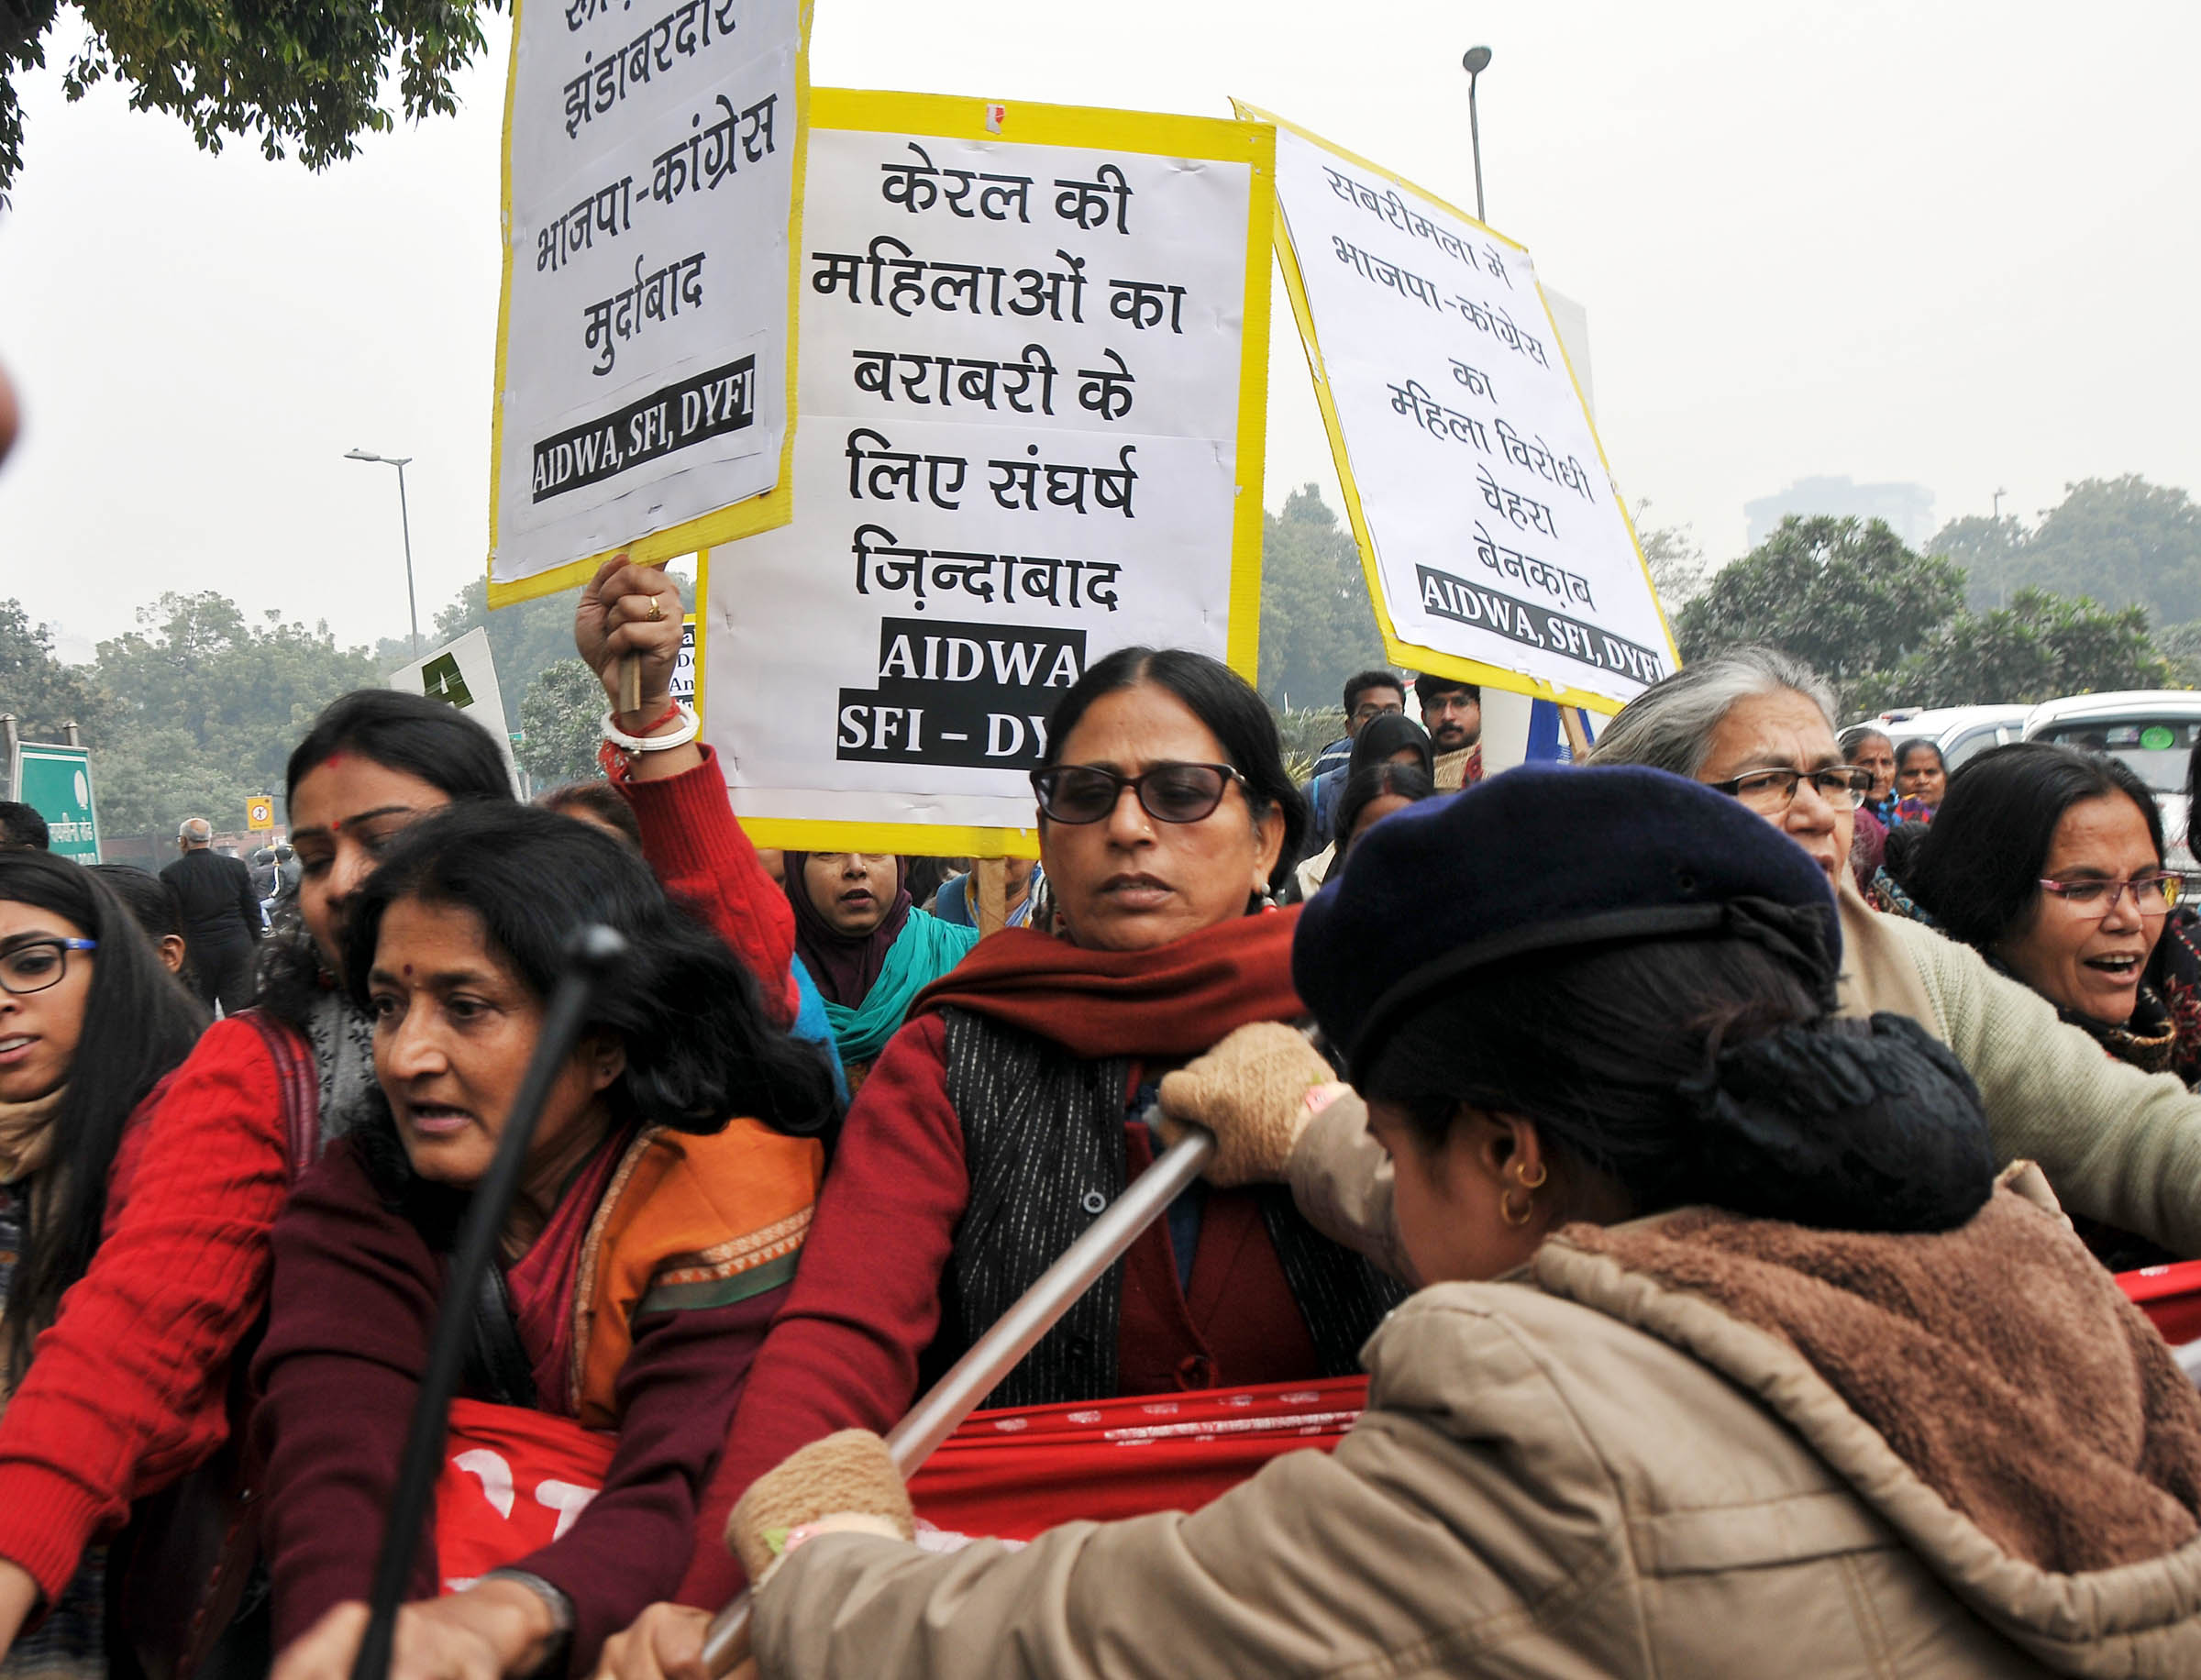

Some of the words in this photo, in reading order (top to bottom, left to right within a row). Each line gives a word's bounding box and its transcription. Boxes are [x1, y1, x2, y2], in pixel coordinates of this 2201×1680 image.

[563, 0, 736, 139] झंडाबरदार
[536, 94, 779, 272] भाजपा-कांग्रेस
[880, 141, 1034, 224] केरल
[1054, 163, 1134, 235] की
[1322, 165, 1480, 271] सबरीमला
[1482, 243, 1514, 291] में
[583, 252, 706, 377] मुर्दाबाद
[812, 235, 1088, 324] महिलाओं
[1109, 279, 1188, 335] का
[1332, 235, 1550, 370] भाजपा-कांग्रेस
[532, 426, 625, 492] AIDWA,
[629, 400, 674, 457] SFI,
[680, 368, 755, 437] DYFI
[852, 343, 1059, 416] बराबरी
[1078, 348, 1135, 421] के
[1447, 357, 1498, 404] का
[845, 427, 969, 511] लिए
[988, 444, 1139, 519] संघर्ष
[1386, 379, 1493, 455] महिला
[1494, 417, 1597, 504] विरोधी
[1475, 462, 1559, 540] चेहरा
[879, 634, 1079, 689] AIDWA
[1422, 574, 1544, 649] AIDWA,
[1547, 616, 1604, 669] SFI,
[1602, 636, 1665, 683] DYFI
[838, 704, 924, 753] SFI
